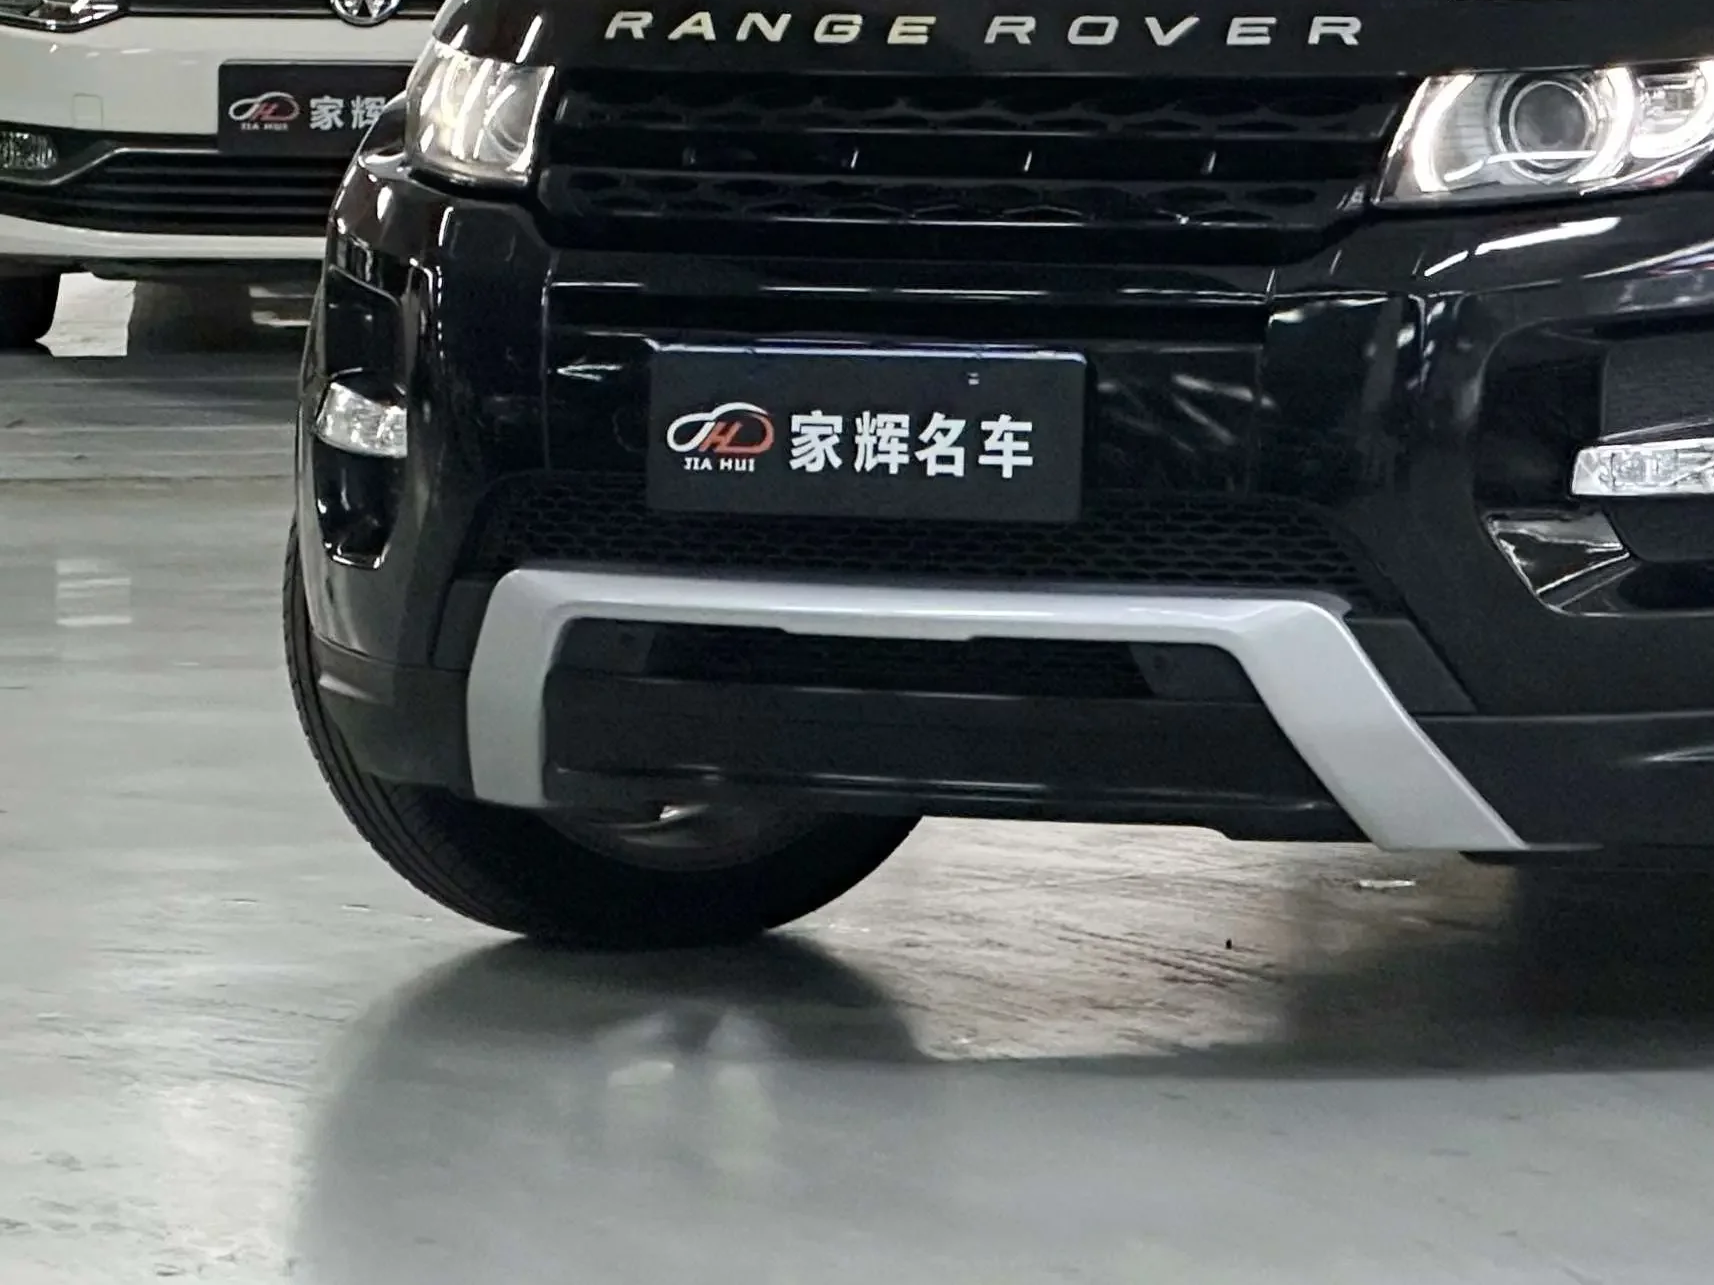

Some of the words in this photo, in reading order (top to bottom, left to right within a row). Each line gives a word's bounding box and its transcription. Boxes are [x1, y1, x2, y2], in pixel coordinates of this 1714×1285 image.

[604, 10, 938, 45] RANGE
[983, 15, 1363, 47] ROVER
[788, 409, 1034, 479] 家辉名车
[683, 457, 713, 472] JIA
[719, 458, 756, 473] HUI
